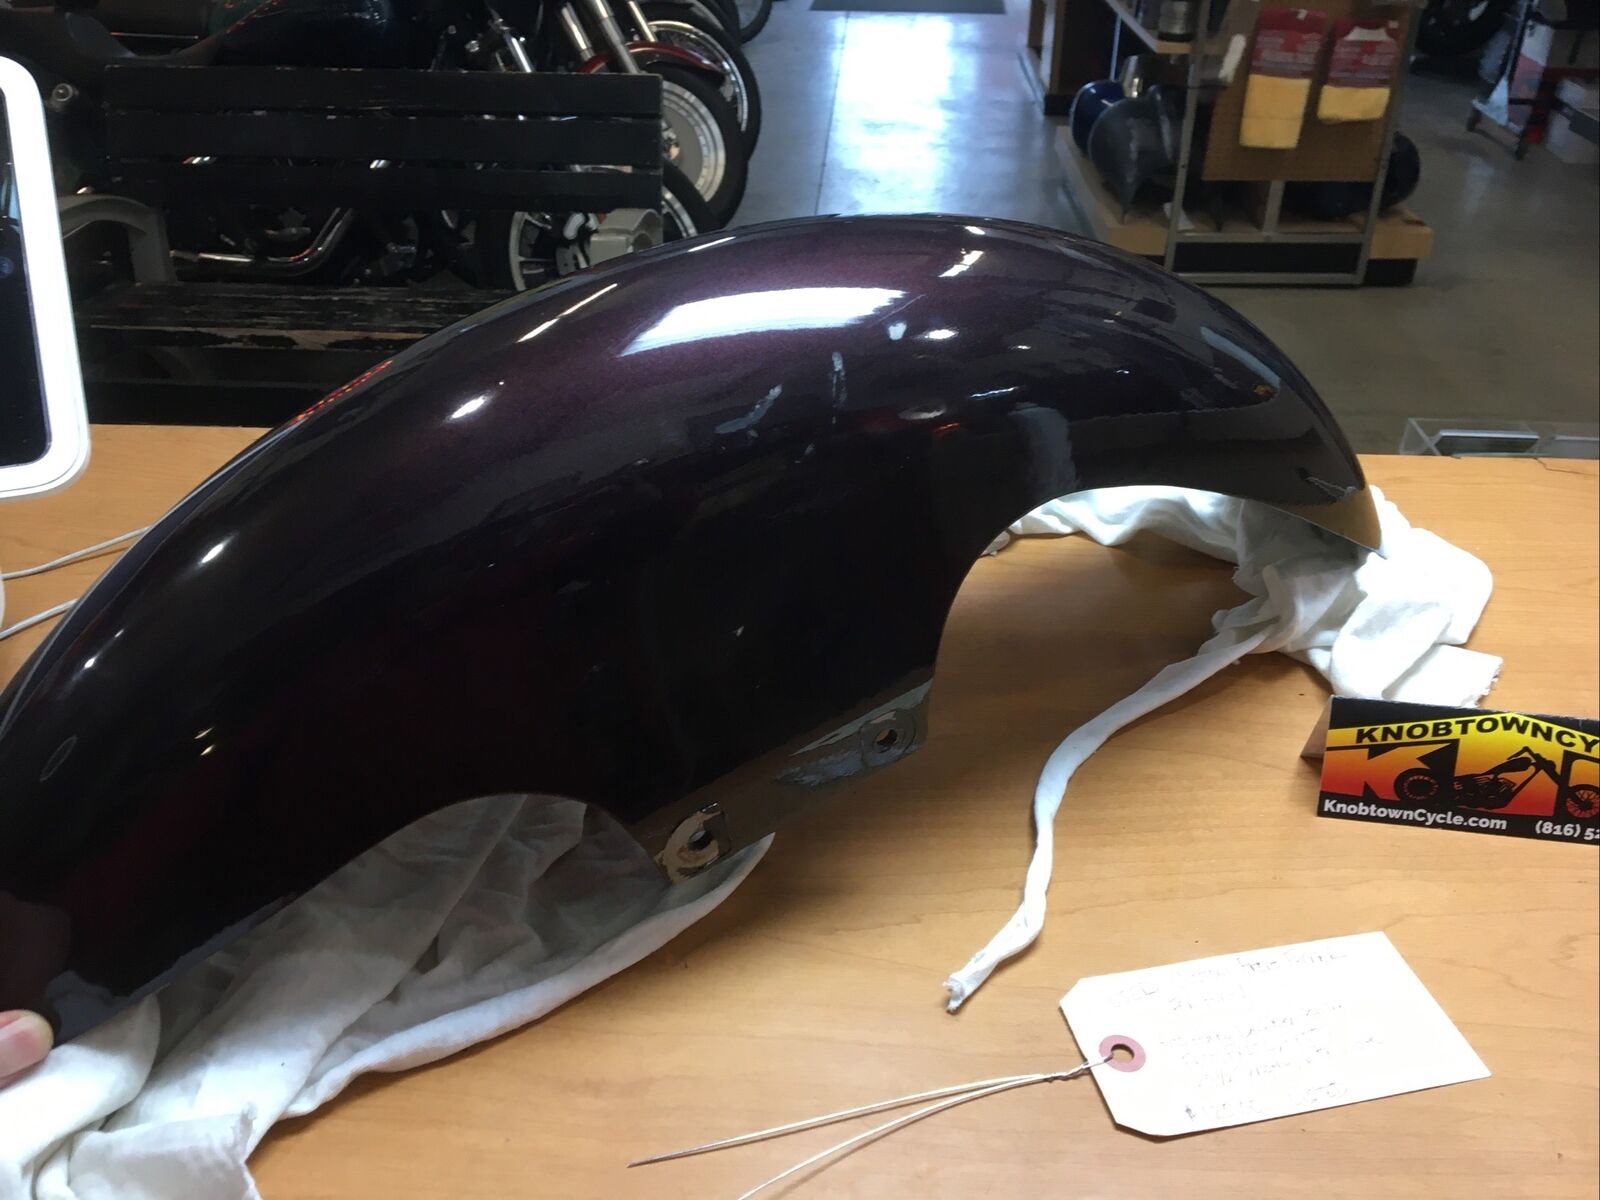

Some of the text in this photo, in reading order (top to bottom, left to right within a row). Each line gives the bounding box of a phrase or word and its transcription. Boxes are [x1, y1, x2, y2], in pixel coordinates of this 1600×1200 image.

[1356, 714, 1599, 753] KNOBTOWNCY
[1323, 799, 1507, 830] KnobtownCycle.com
[1535, 820, 1581, 837] (816)
